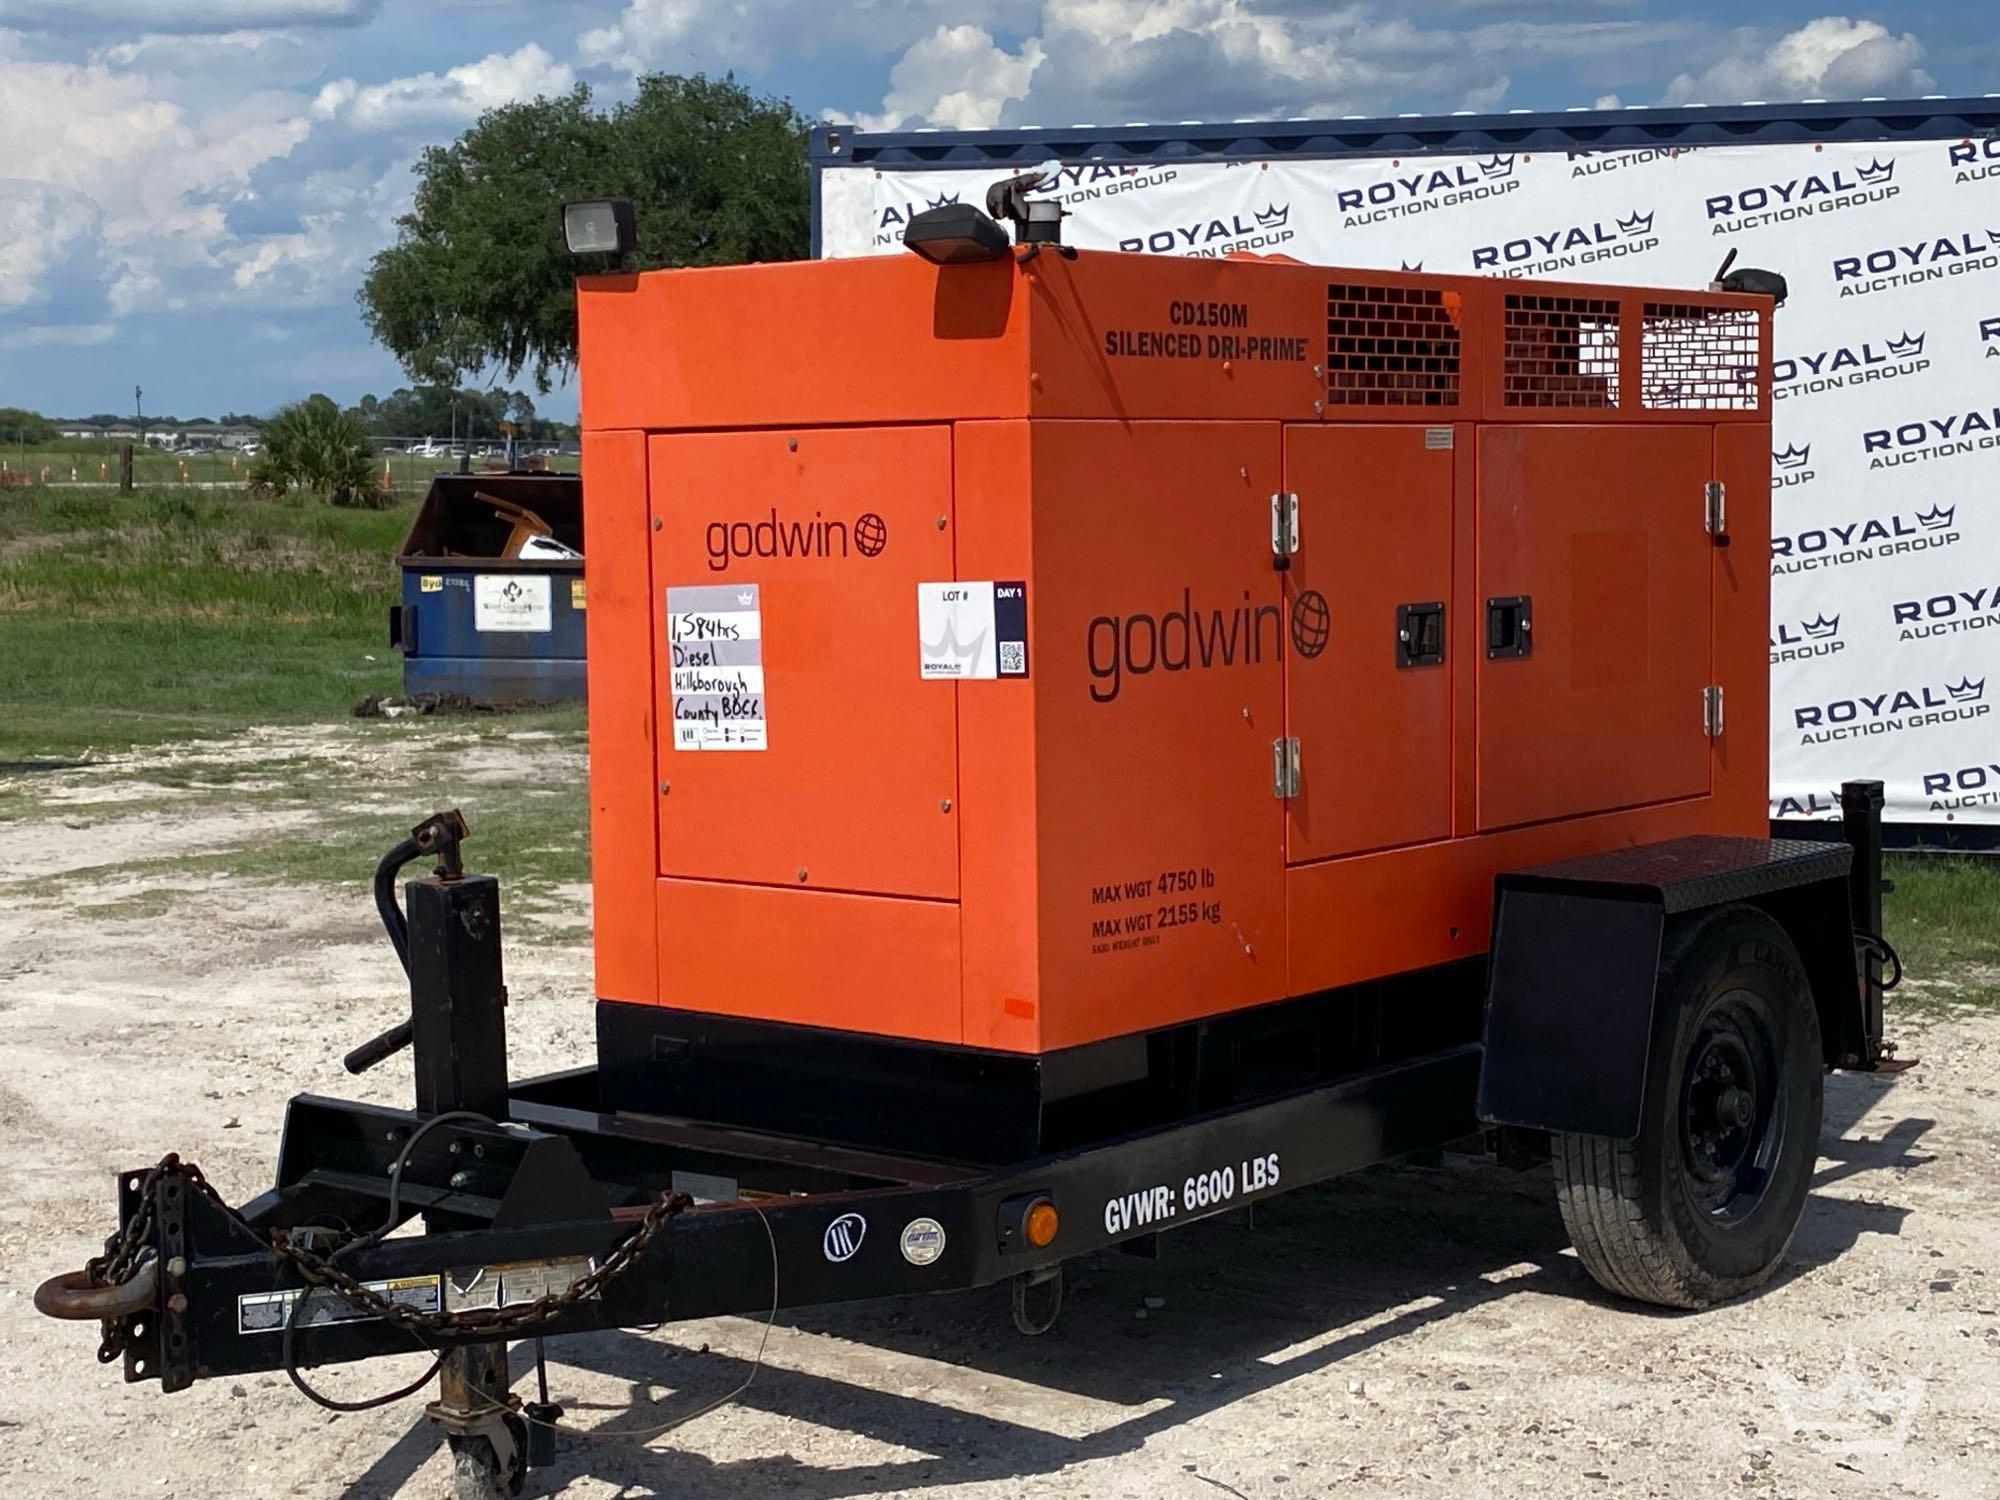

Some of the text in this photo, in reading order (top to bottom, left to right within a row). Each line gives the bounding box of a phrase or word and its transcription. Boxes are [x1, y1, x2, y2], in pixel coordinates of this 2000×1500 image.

[1105, 170, 1177, 195] GROUP
[1337, 166, 1479, 212] ROYAL
[1706, 171, 1857, 219] ROYAL
[1343, 180, 1520, 229] AUCTION GROUP
[1712, 186, 1900, 236] AUCTION GROUP
[1472, 223, 1617, 269] ROYAL
[1492, 237, 1659, 279] CTION GROUP
[1833, 233, 1987, 281] ROYAL
[1840, 255, 2000, 298] AUCTION GRO
[1169, 301, 1248, 328] CD150M
[1105, 331, 1309, 361] SILENCED DRI-PRIME
[1849, 359, 1930, 384] GROUP
[1869, 439, 1973, 470] AUCTION
[1772, 470, 1815, 488] OUP
[706, 507, 847, 571] godwin
[1771, 516, 1916, 559] ROYAL
[1771, 532, 1960, 576] AUCTION GROUP
[942, 591, 960, 602] LOT
[997, 588, 1015, 599] DAY
[1017, 588, 1023, 598] 1
[1893, 586, 2000, 625] ROY
[672, 641, 718, 668] Diesel
[1087, 587, 1282, 703] godwin
[675, 670, 748, 700] Hillsborough
[675, 697, 719, 728] County
[1794, 687, 1946, 729] ROYAL
[1800, 704, 1990, 746] AUCTION GROUP
[1929, 790, 2000, 812] AUCTI
[1092, 868, 1215, 904] MAX WGT 4750 lb
[1092, 900, 1221, 938] MAX WGT 2155 kg
[1104, 1152, 1280, 1235] GVWR: 6600 LBS
